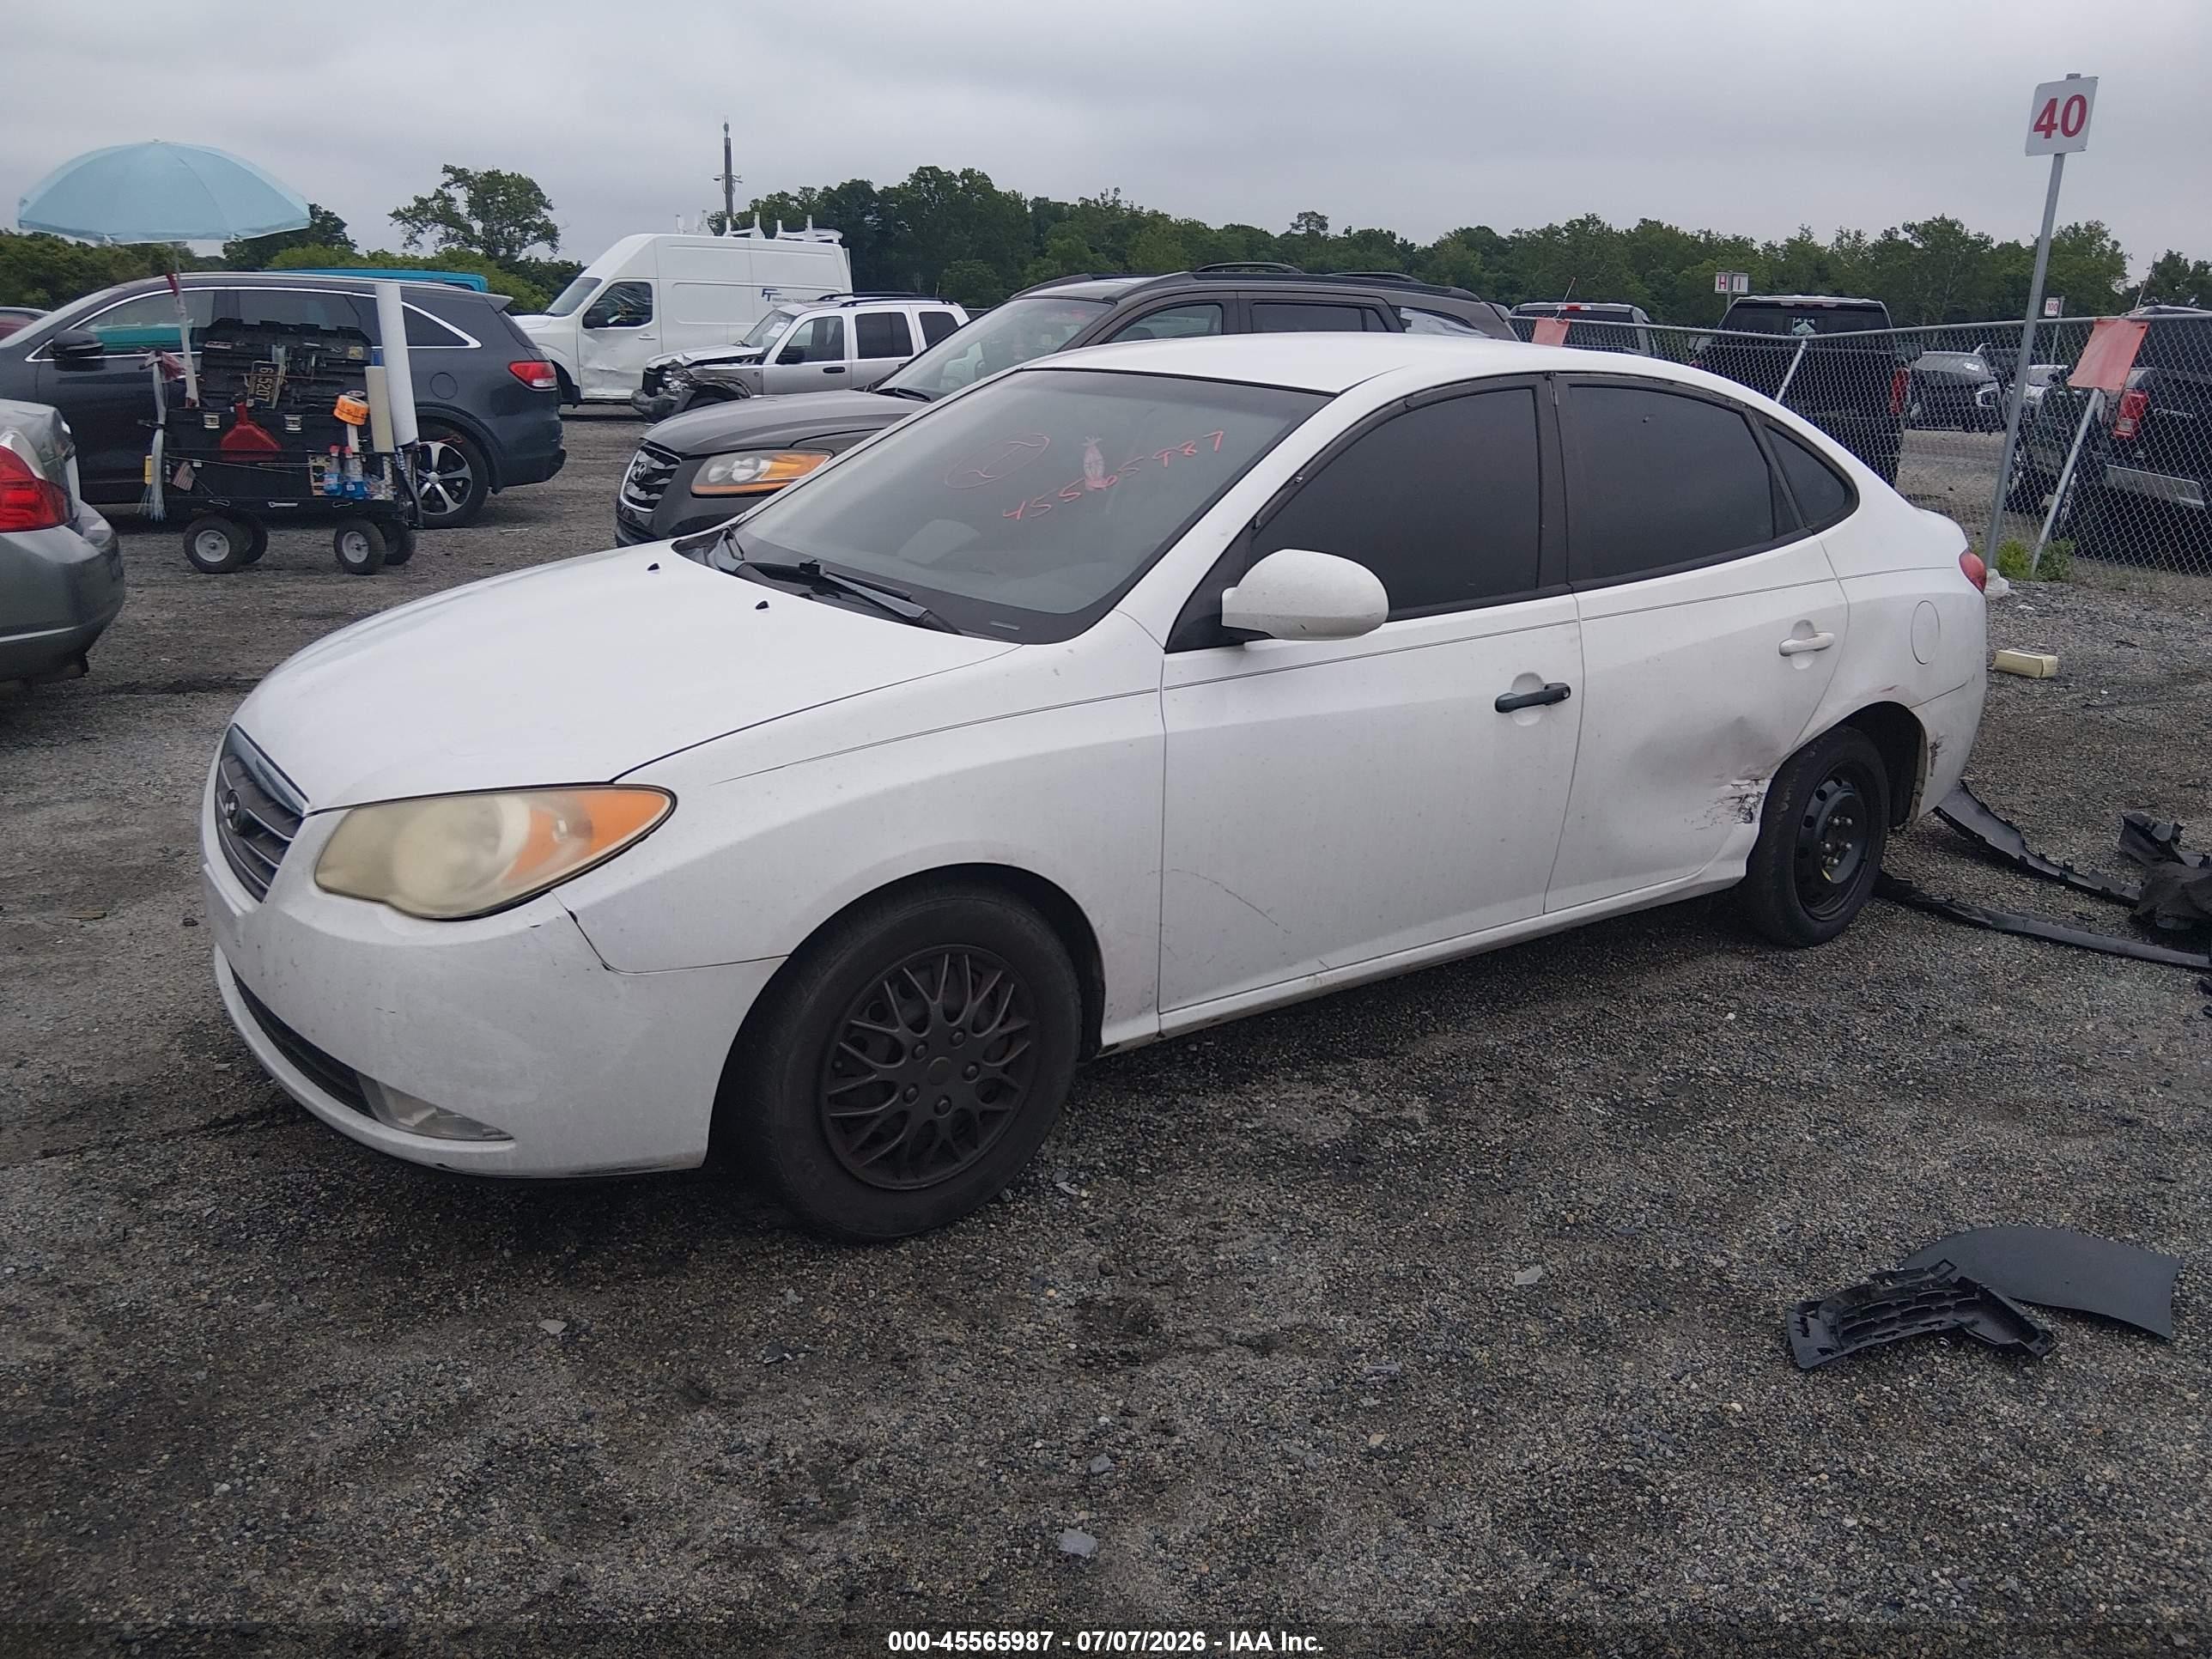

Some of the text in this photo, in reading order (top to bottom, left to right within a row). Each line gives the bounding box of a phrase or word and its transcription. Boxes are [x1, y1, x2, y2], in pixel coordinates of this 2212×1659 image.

[2033, 94, 2087, 139] 40
[1718, 274, 1728, 290] H
[2047, 302, 2059, 312] 100
